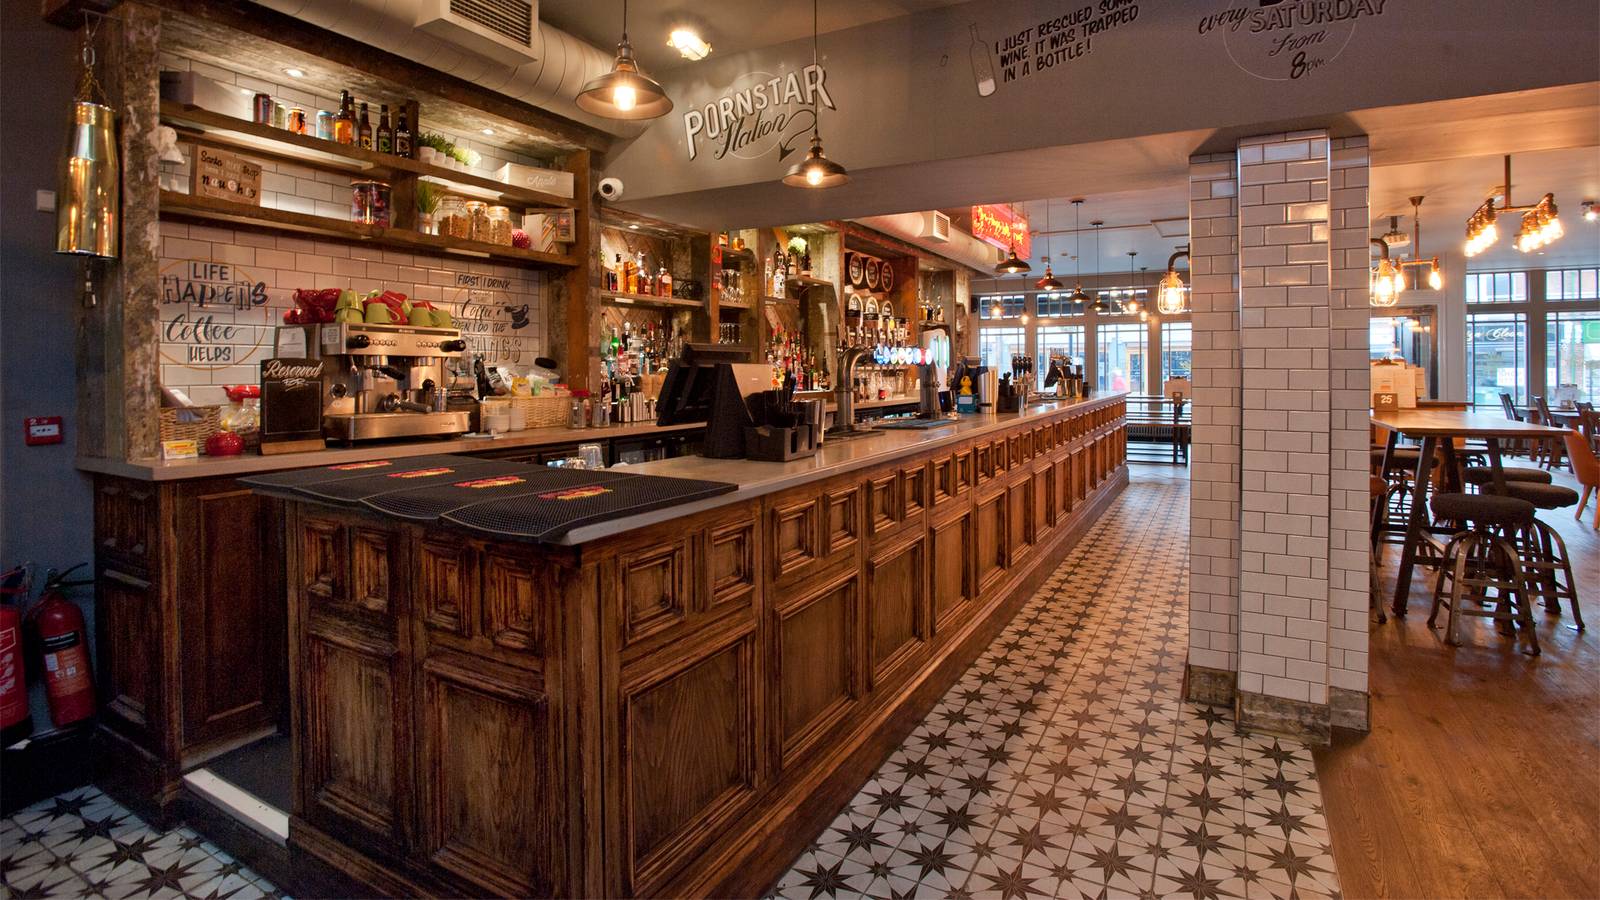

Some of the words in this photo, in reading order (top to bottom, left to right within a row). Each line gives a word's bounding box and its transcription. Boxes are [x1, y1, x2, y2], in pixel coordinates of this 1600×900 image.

[995, 41, 1000, 55] I
[1002, 28, 1034, 52] JUST
[1038, 6, 1093, 38] RESCUED
[1100, 0, 1132, 14] SOM
[1198, 6, 1250, 35] every
[1248, 0, 1386, 33] SATURDAY
[1035, 39, 1047, 55] IT
[1050, 29, 1076, 50] WAS
[1082, 5, 1139, 37] TRAPPED
[1003, 66, 1016, 83] IN
[1022, 61, 1031, 76] A
[682, 63, 837, 161] PORNSTAR
[193, 262, 229, 281] LIFE
[487, 277, 512, 290] DRINK
[189, 346, 232, 362] HELPS
[262, 359, 324, 378] Reserved
[1380, 394, 1393, 404] 25
